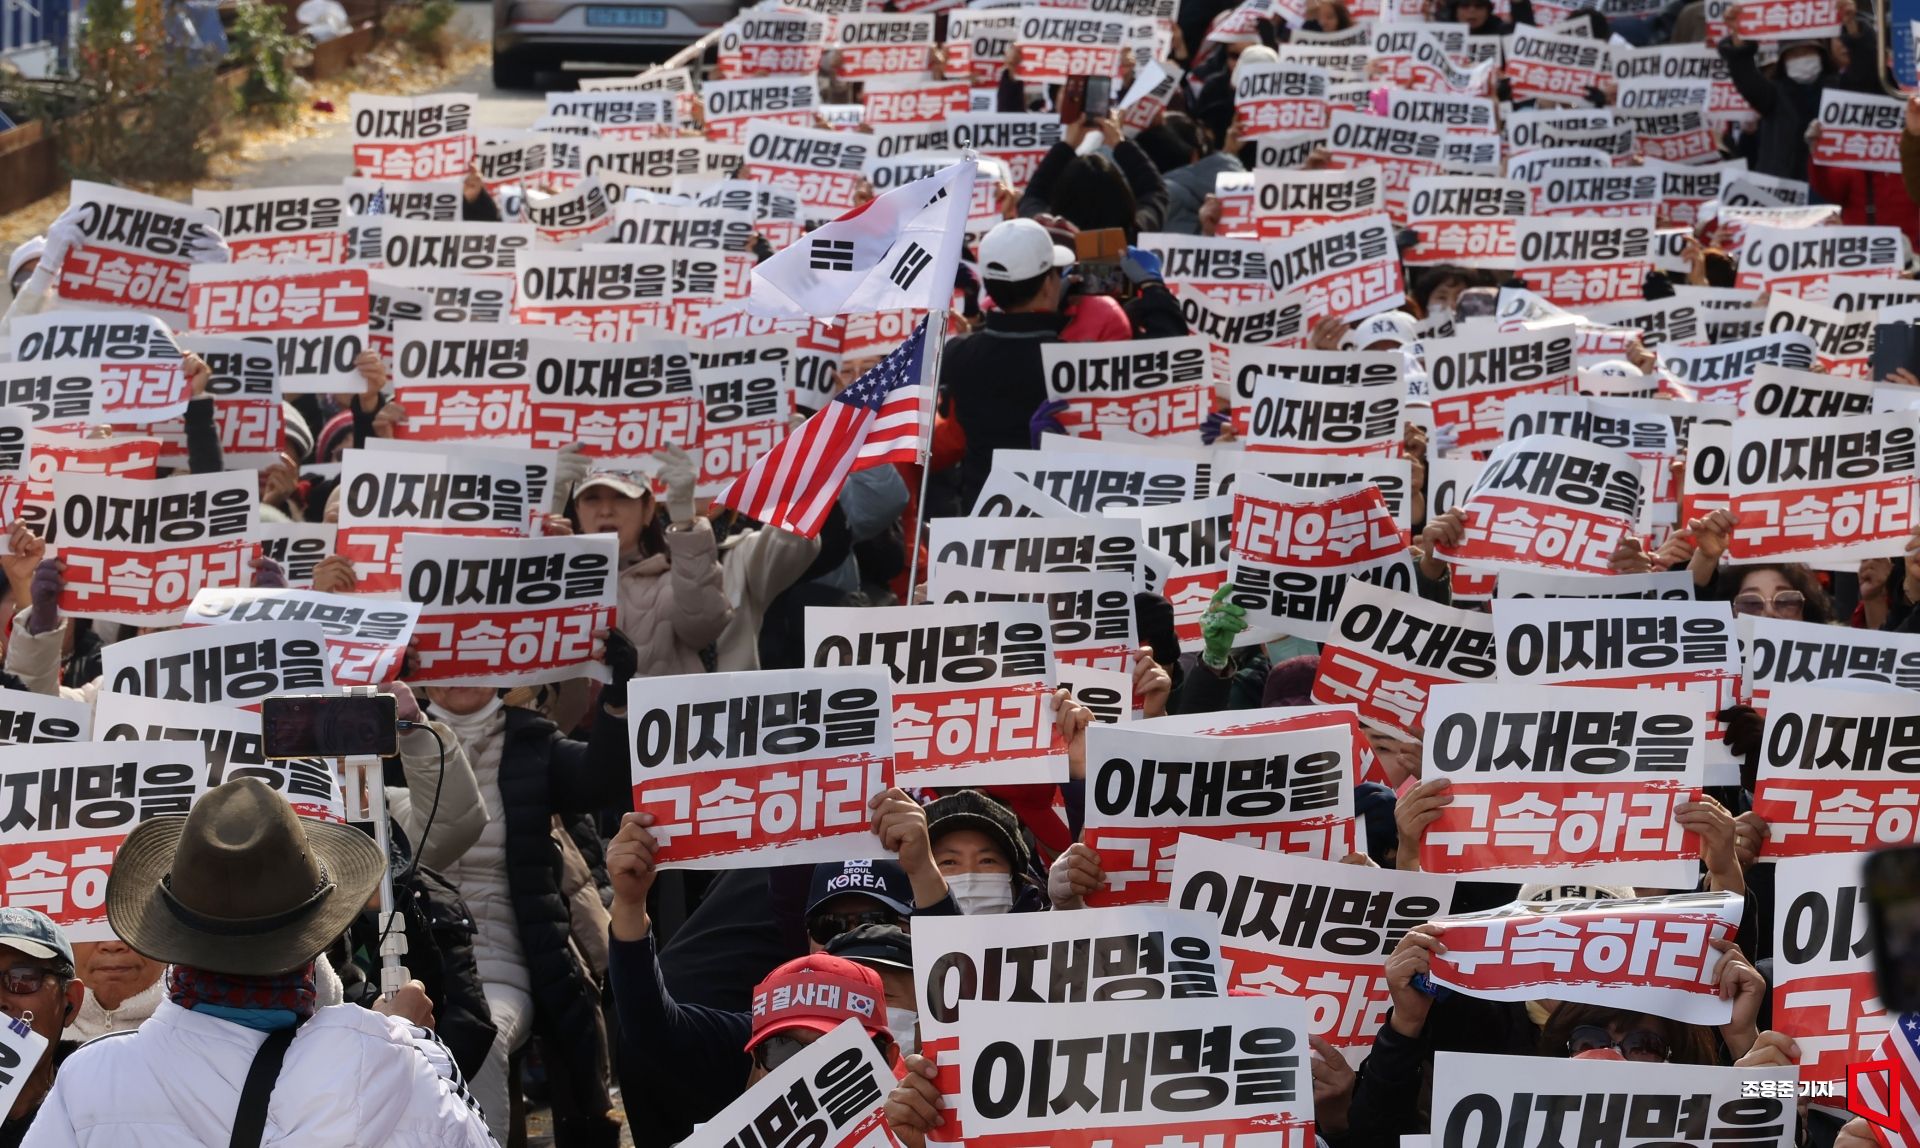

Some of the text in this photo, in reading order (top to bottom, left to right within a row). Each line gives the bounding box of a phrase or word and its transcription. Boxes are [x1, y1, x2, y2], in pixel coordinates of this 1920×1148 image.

[1023, 18, 1123, 43] 이재명을
[1617, 58, 1660, 78] 이재
[355, 103, 471, 139] 이재명을
[1824, 102, 1900, 130] 이재명
[749, 134, 866, 168] 이재명을
[1332, 122, 1441, 158] 이재명을
[1449, 143, 1494, 165] 명을
[1816, 132, 1901, 158] 구속하
[1260, 177, 1377, 211] 이재명을
[1412, 187, 1527, 217] 이재명을
[1661, 172, 1721, 197] 재명
[1270, 227, 1387, 291] 이재명을
[1520, 228, 1649, 261] 이재명을
[1768, 236, 1897, 272] 이재명을
[434, 287, 503, 322] 명을
[523, 265, 664, 300] 이재명을
[399, 339, 529, 380] 이재명
[536, 352, 694, 398] 이재명을
[1051, 347, 1205, 393] 이재명을
[1433, 336, 1573, 391] 이재명을
[101, 365, 190, 409] 하라
[705, 378, 778, 422] 명을
[401, 390, 531, 432] 구속하
[1253, 397, 1399, 442] 이재명을
[1736, 426, 1917, 485] 이재명을
[63, 488, 250, 544] 이재명을
[346, 472, 522, 522] 이재명을
[409, 553, 609, 607] 이재명을
[1340, 604, 1497, 680] 이재명
[1506, 615, 1729, 676] 이재명을
[112, 638, 325, 703] 이재명을
[1321, 653, 1429, 728] 구속
[636, 688, 880, 768] 이재명을
[893, 692, 1057, 762] 속하라
[1432, 711, 1694, 774] 이재명을
[0, 761, 196, 834] 재명을
[1094, 750, 1343, 818] 이재명을
[1761, 788, 1920, 846] 구속하
[827, 873, 887, 892] KOREA
[843, 867, 871, 875] SEOUL
[772, 983, 840, 1012] 결사대
[971, 1025, 1300, 1120] 이재명을
